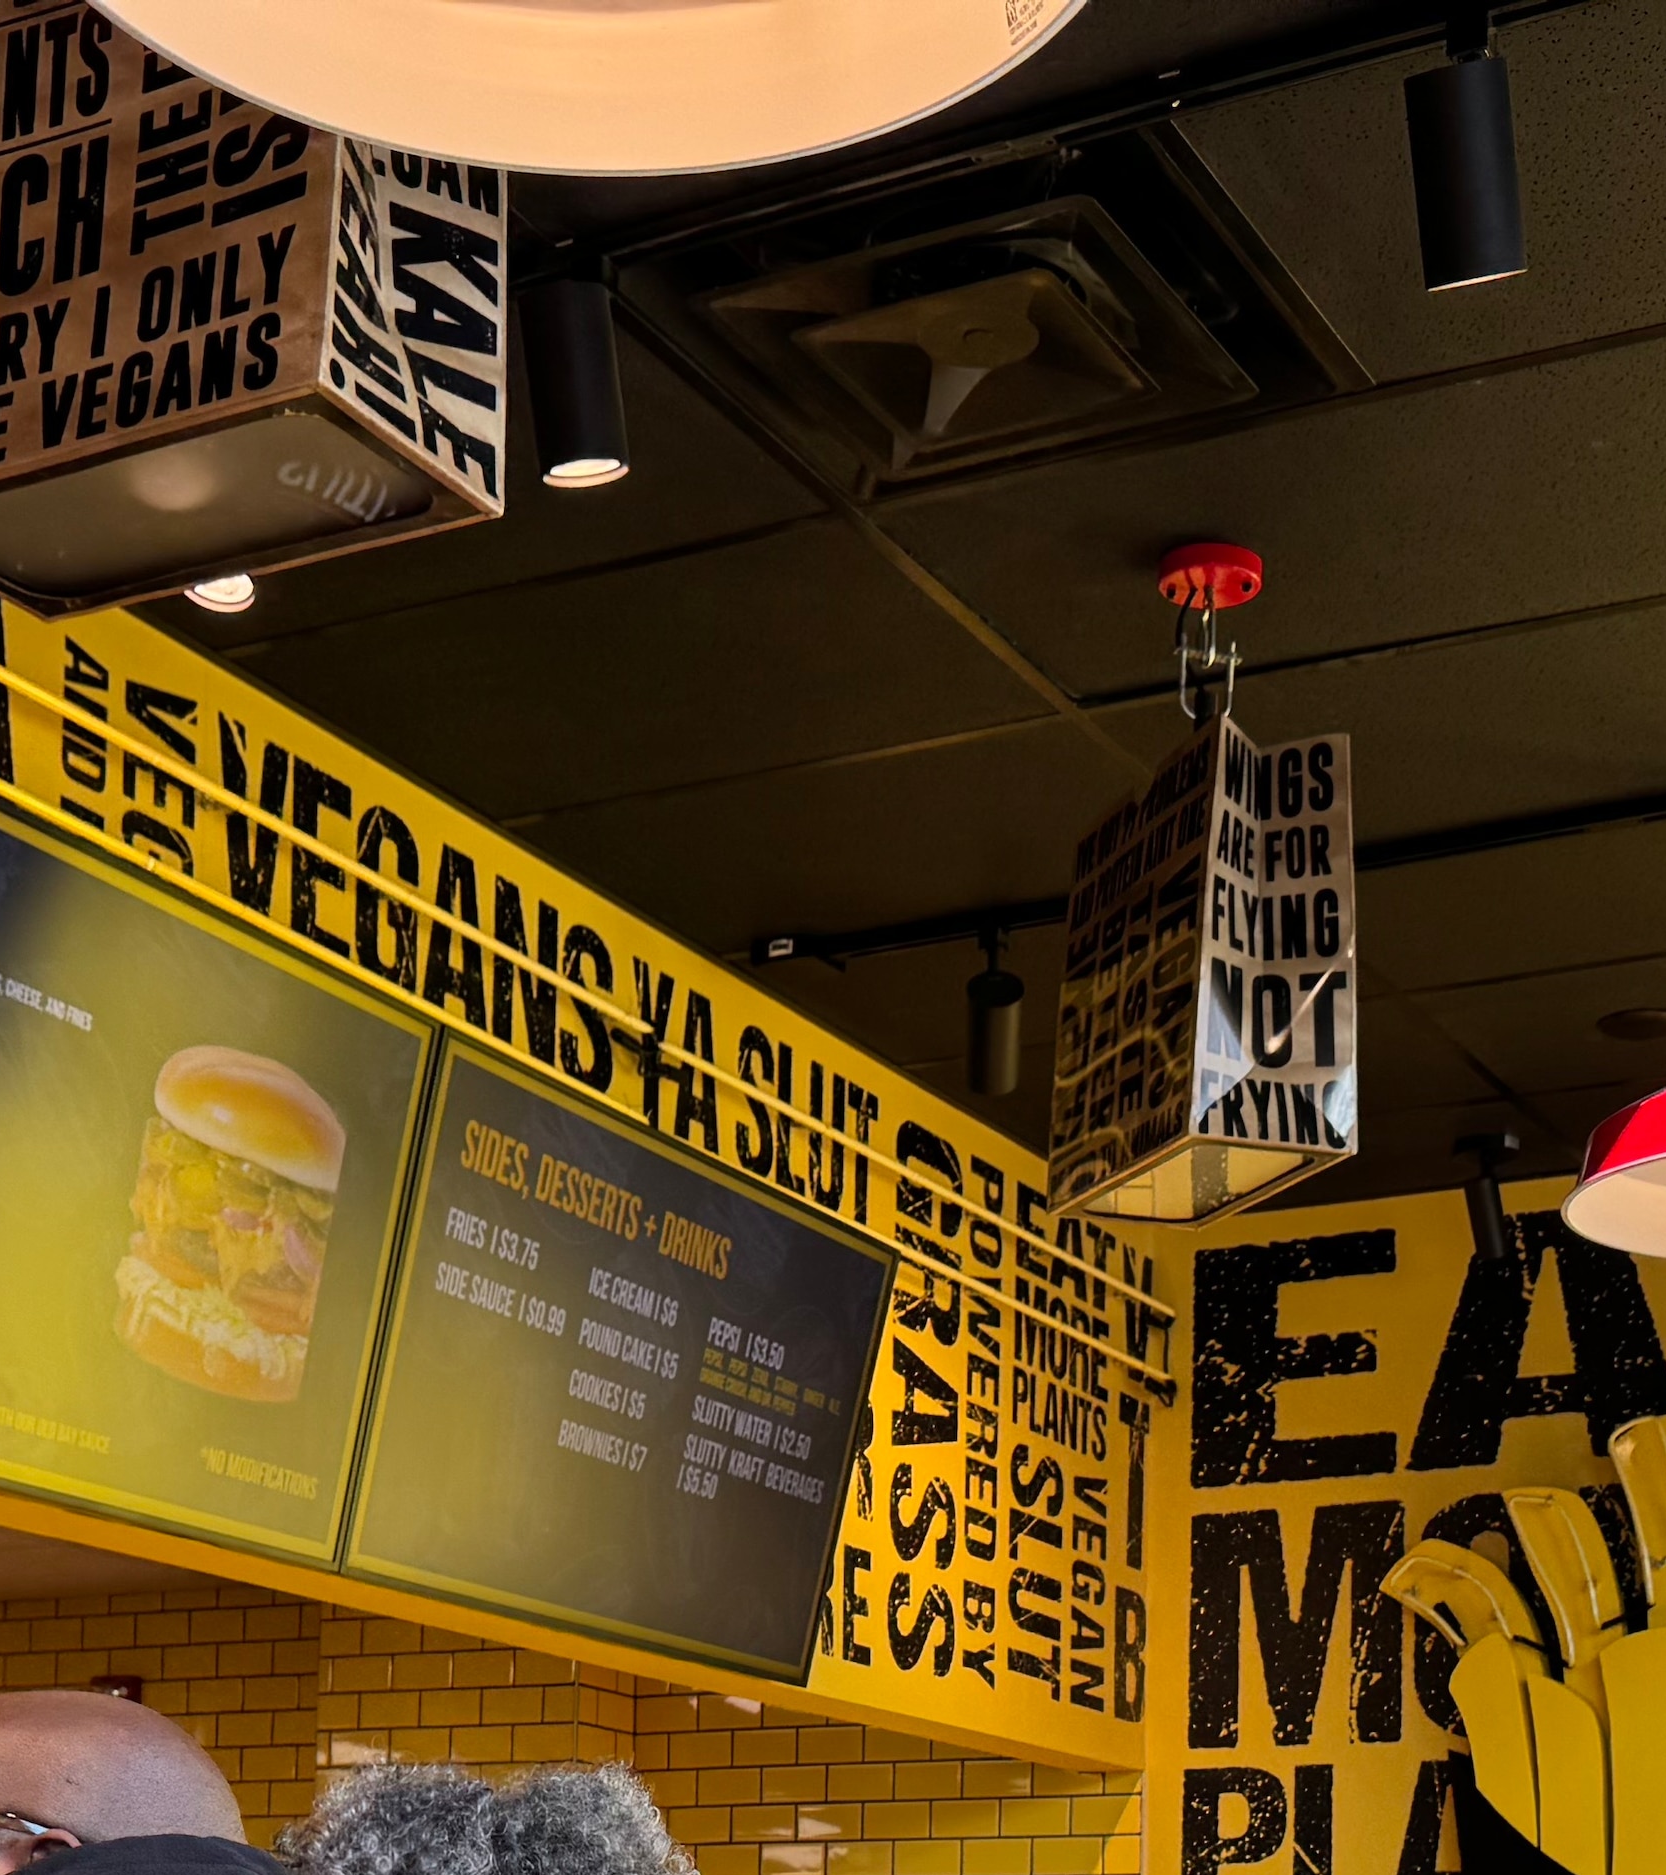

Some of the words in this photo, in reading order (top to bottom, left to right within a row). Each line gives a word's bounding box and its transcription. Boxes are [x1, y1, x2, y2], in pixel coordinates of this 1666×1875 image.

[90, 284, 111, 361] I
[136, 223, 297, 344] ONLY
[40, 311, 283, 450] VEGANS
[389, 201, 499, 501] KALE
[1224, 727, 1334, 821] WINGS
[1216, 809, 1255, 880] ARE
[1264, 823, 1333, 884] FOR
[1211, 873, 1340, 963] FLYING
[217, 708, 614, 1095] VEGANS
[735, 1024, 880, 1227] SLUT
[1205, 957, 1347, 1070] NOT
[1197, 1066, 1349, 1150] FRYING
[445, 1206, 488, 1251] FRIES
[460, 1118, 531, 1201] SIDES,
[535, 1152, 644, 1242] DESSERTS
[658, 1210, 733, 1282] DRINKS
[1015, 1179, 1117, 1313] EAT
[435, 1261, 471, 1301] SIDE
[469, 1269, 517, 1319] SAUCE
[588, 1265, 610, 1302] ICE
[609, 1272, 654, 1321] CREAM
[707, 1315, 743, 1355] PEPSI
[578, 1317, 621, 1360] POUND
[620, 1332, 655, 1373] CAKE
[963, 1153, 1005, 1563] POWERED
[1013, 1273, 1110, 1404] MORE
[568, 1367, 624, 1413] COOKIES
[691, 1393, 736, 1434] SLUTTY
[733, 1405, 775, 1448] WATER
[887, 1118, 964, 1680] GRASS
[1012, 1364, 1108, 1463] PLANTS
[225, 1452, 320, 1501] MODIFICATIONS
[557, 1418, 624, 1468] BROWNIES
[683, 1432, 727, 1471] SLUTTY
[726, 1444, 766, 1485] KRAFT
[764, 1461, 826, 1506] BEVERAGES
[1006, 1442, 1065, 1703] SLUT
[1070, 1474, 1109, 1714] VEGAN
[961, 1576, 997, 1691] BY
